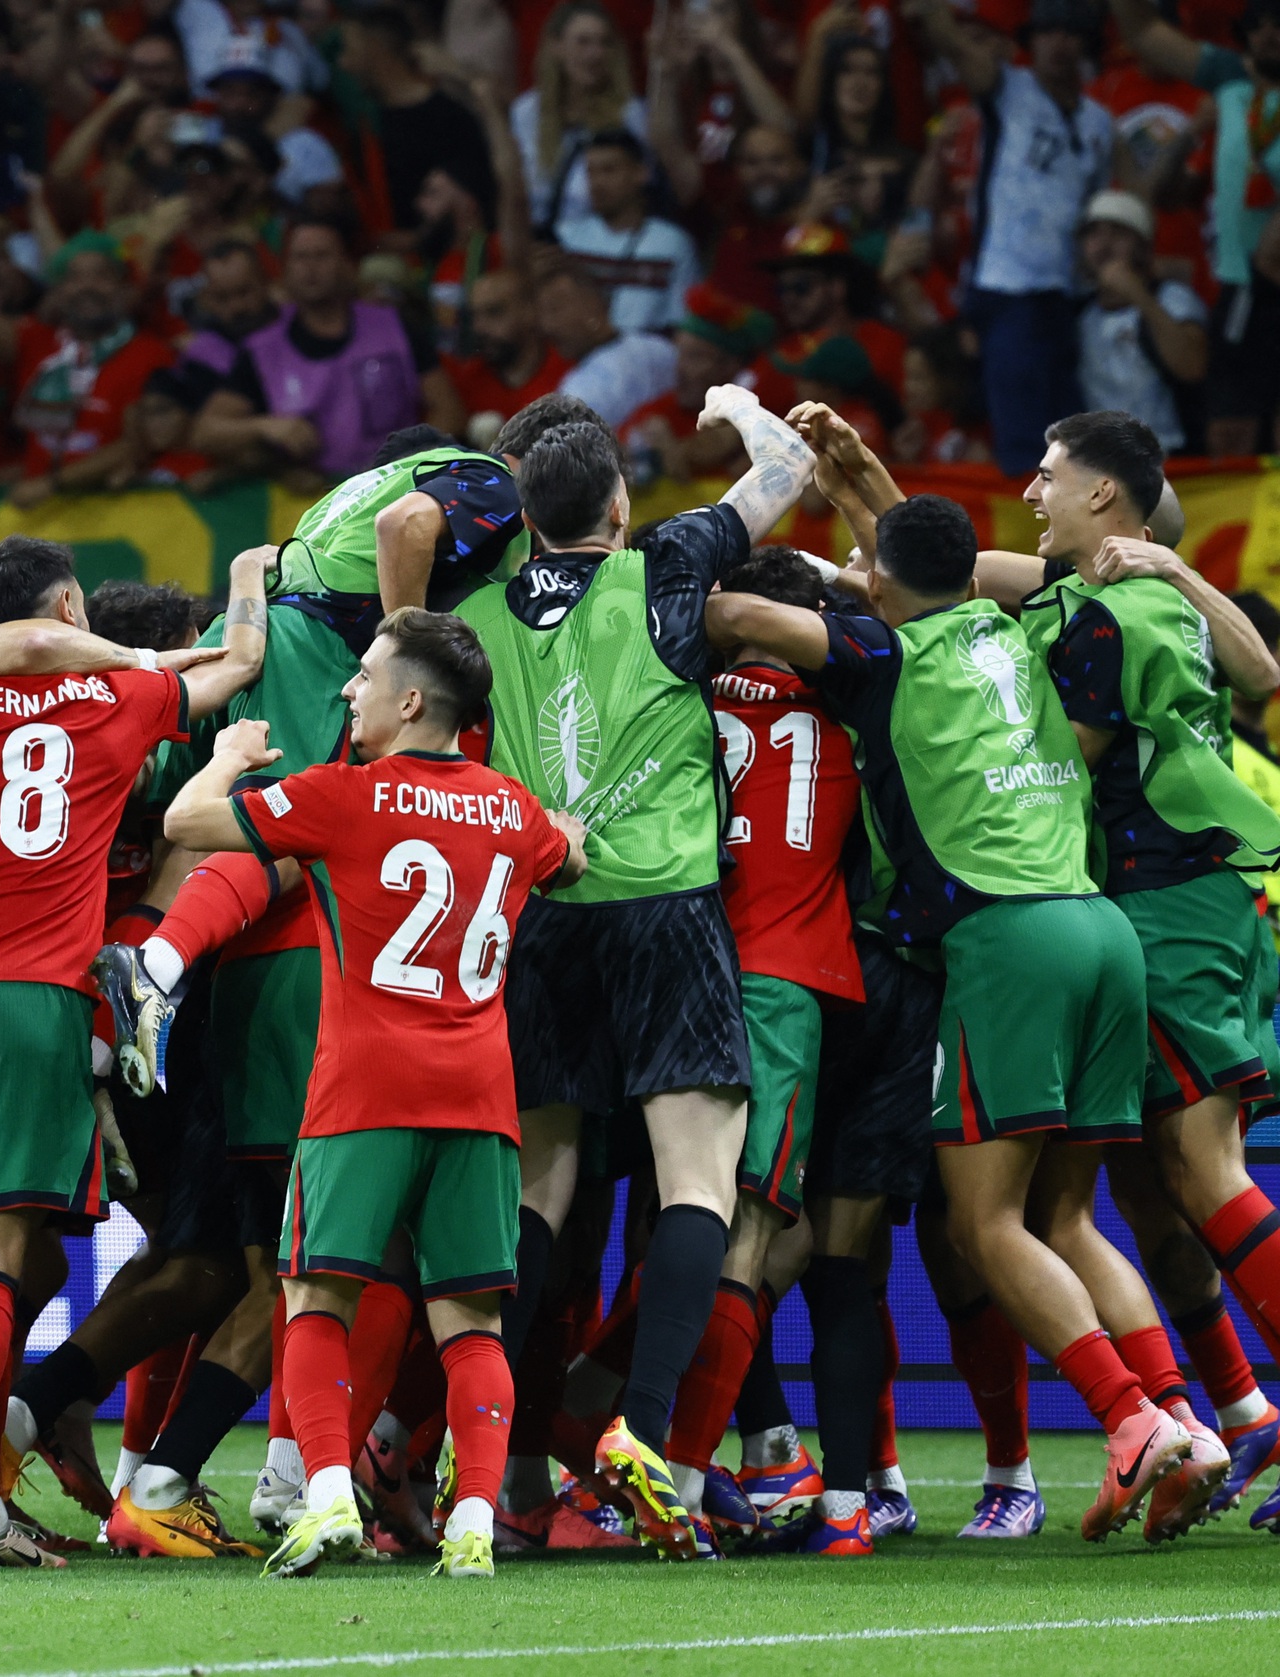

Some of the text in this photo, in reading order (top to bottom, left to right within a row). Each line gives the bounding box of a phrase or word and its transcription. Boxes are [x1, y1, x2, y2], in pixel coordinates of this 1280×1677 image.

[529, 568, 582, 599] JOS
[711, 673, 777, 702] IOGO
[713, 710, 821, 852] 21
[373, 782, 523, 835] F.CONCEIÇÃO
[371, 838, 515, 1004] 26
